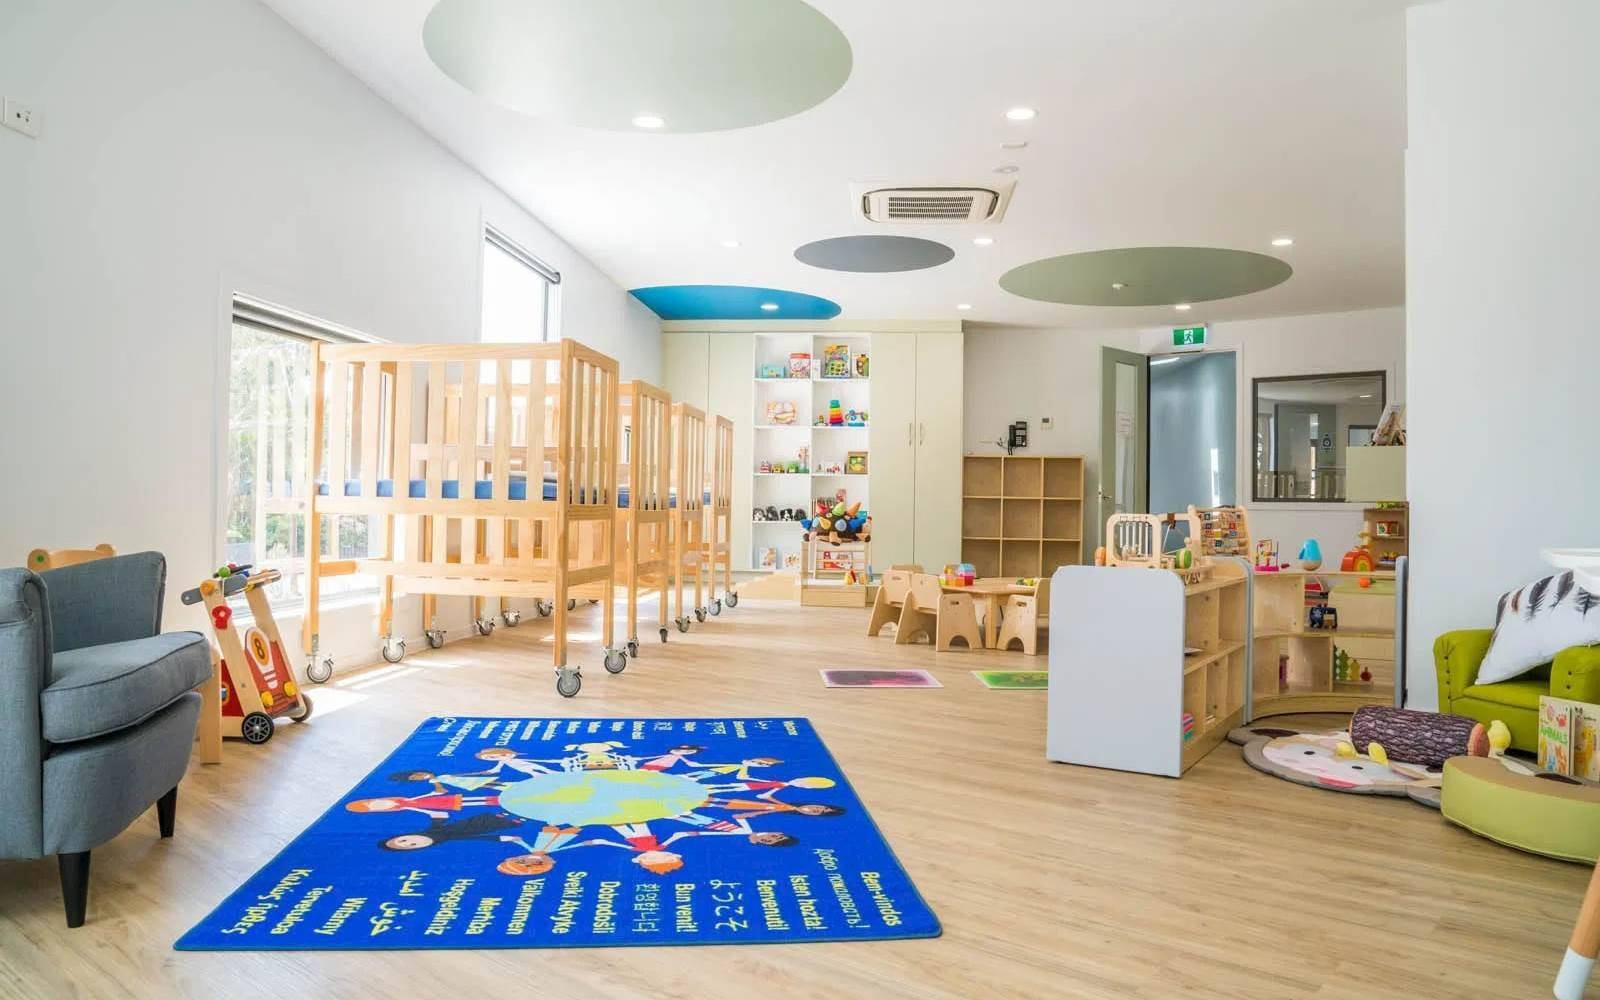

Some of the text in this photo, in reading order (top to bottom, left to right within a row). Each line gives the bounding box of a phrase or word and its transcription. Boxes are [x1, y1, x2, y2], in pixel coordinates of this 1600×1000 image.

[254, 638, 265, 659] 8
[271, 886, 332, 934] Tervetuloa
[314, 898, 367, 934] Witamy
[550, 872, 587, 933] Sveiki Atvyke
[675, 884, 697, 932] Bun venit!
[710, 880, 748, 931] ようこそ
[757, 880, 789, 930] Benvenuti!
[790, 875, 827, 929] Isten hozta!
[861, 872, 902, 926] Bem-vindos
